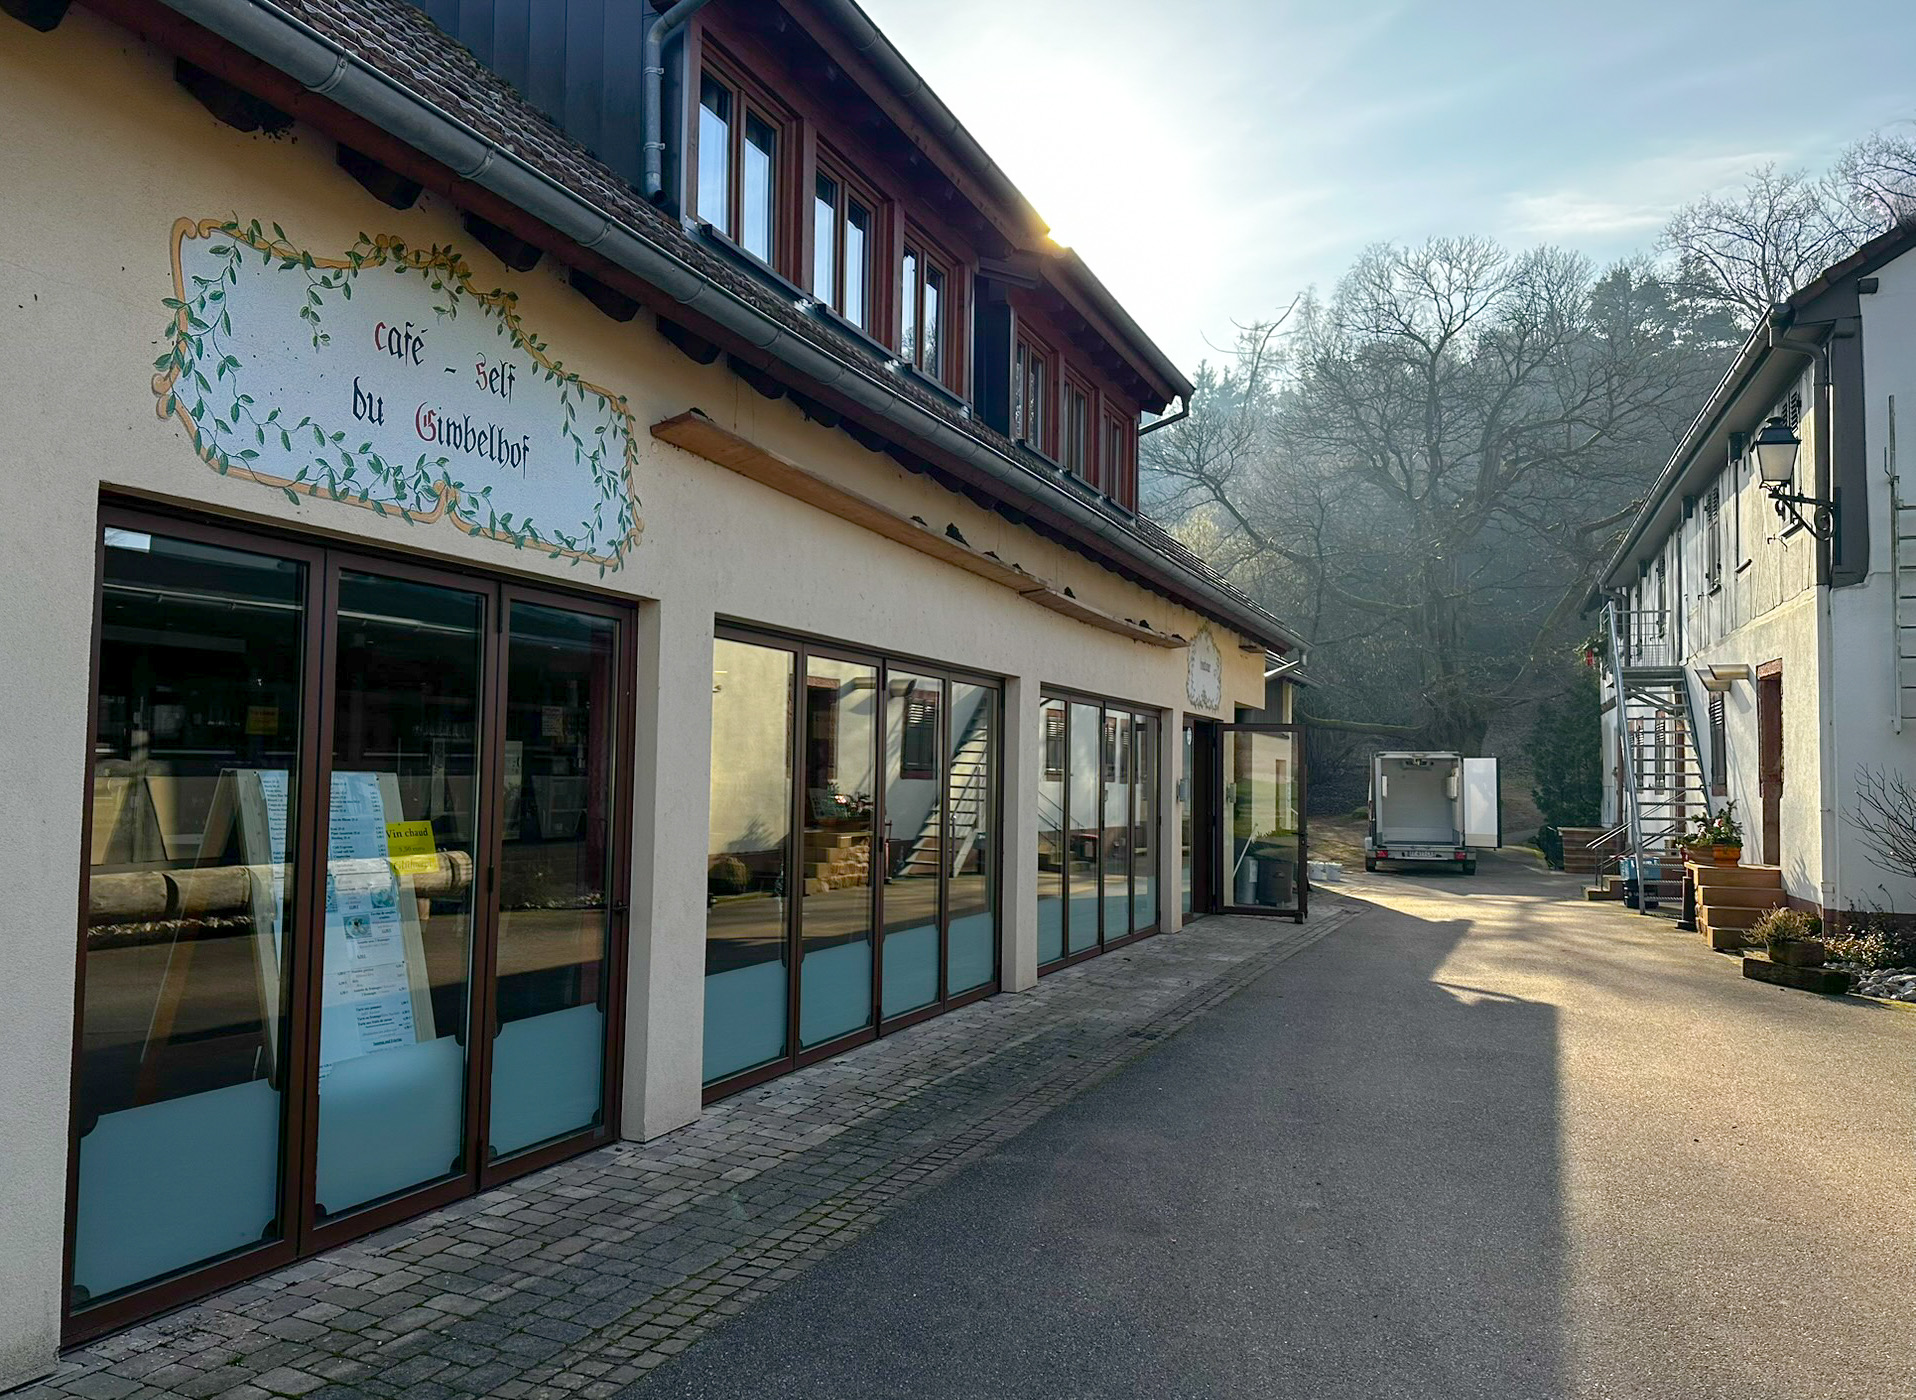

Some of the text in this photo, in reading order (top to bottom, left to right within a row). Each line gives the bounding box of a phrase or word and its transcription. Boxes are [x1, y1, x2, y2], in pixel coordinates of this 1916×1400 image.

[352, 376, 530, 480] du Gimbelhof
[386, 829, 403, 838] Vin
[404, 827, 429, 837] chaud
